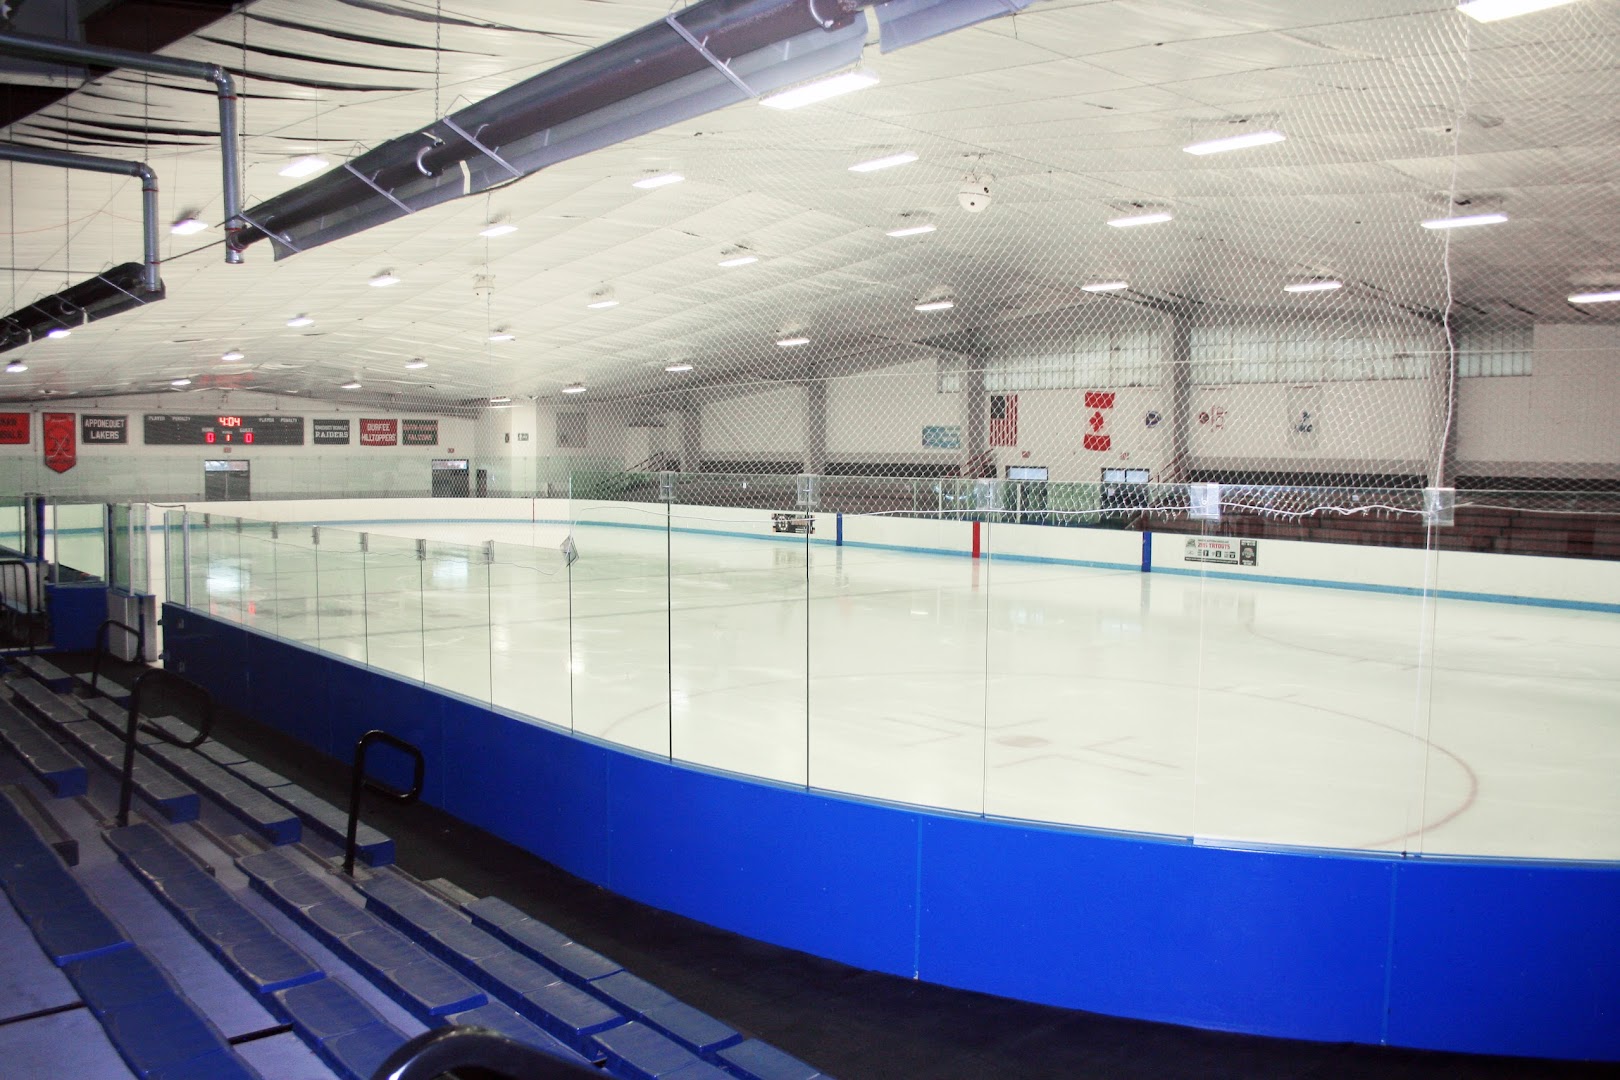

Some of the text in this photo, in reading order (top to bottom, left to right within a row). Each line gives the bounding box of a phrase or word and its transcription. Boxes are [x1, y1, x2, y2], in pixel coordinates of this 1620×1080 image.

[84, 419, 124, 428] APPONEQUET
[219, 416, 241, 426] 4:04
[367, 423, 391, 431] DURFEE
[90, 430, 119, 439] LAKERS
[245, 433, 252, 443] 0
[361, 433, 396, 441] HILLTOPPERS
